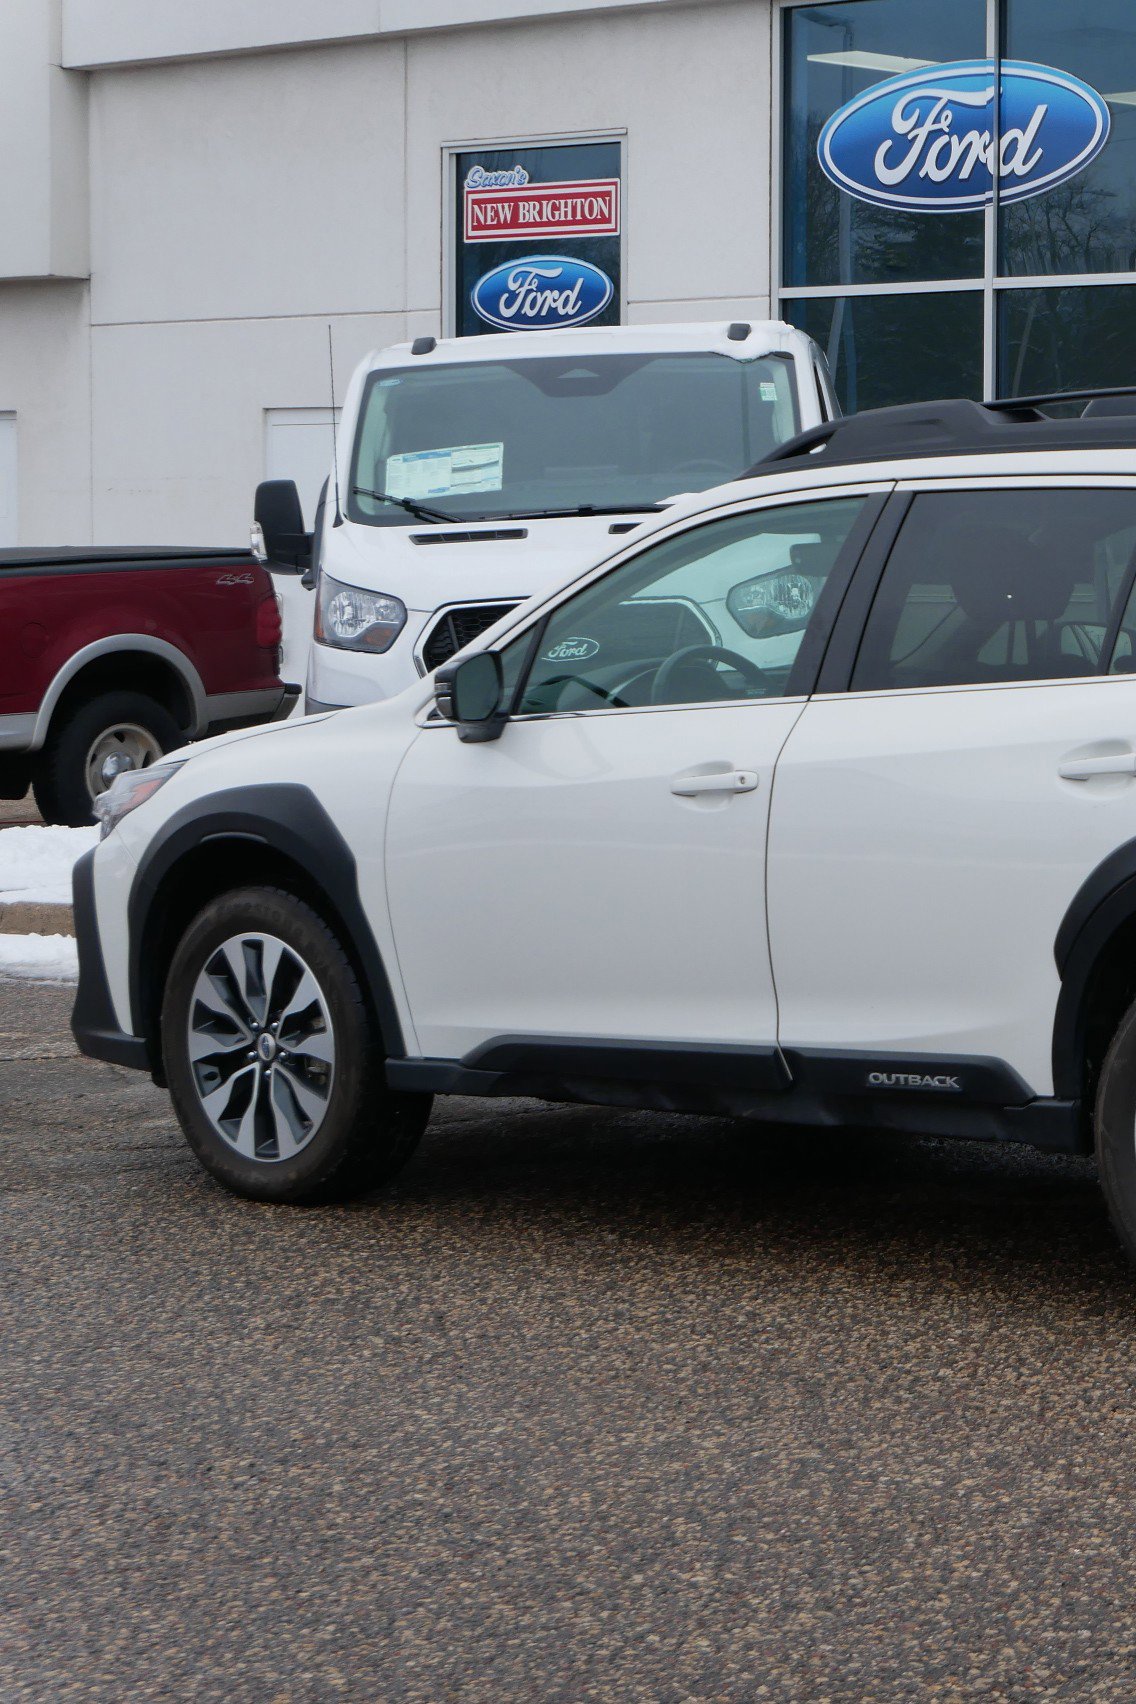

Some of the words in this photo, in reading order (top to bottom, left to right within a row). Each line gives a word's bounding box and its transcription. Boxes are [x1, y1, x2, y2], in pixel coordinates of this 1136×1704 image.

[874, 87, 1048, 185] Ford
[473, 202, 515, 226] NEW
[518, 197, 610, 223] BRIGHTON
[499, 266, 585, 318] Ford
[548, 641, 588, 658] Ford
[868, 1072, 960, 1088] OUTBACK
